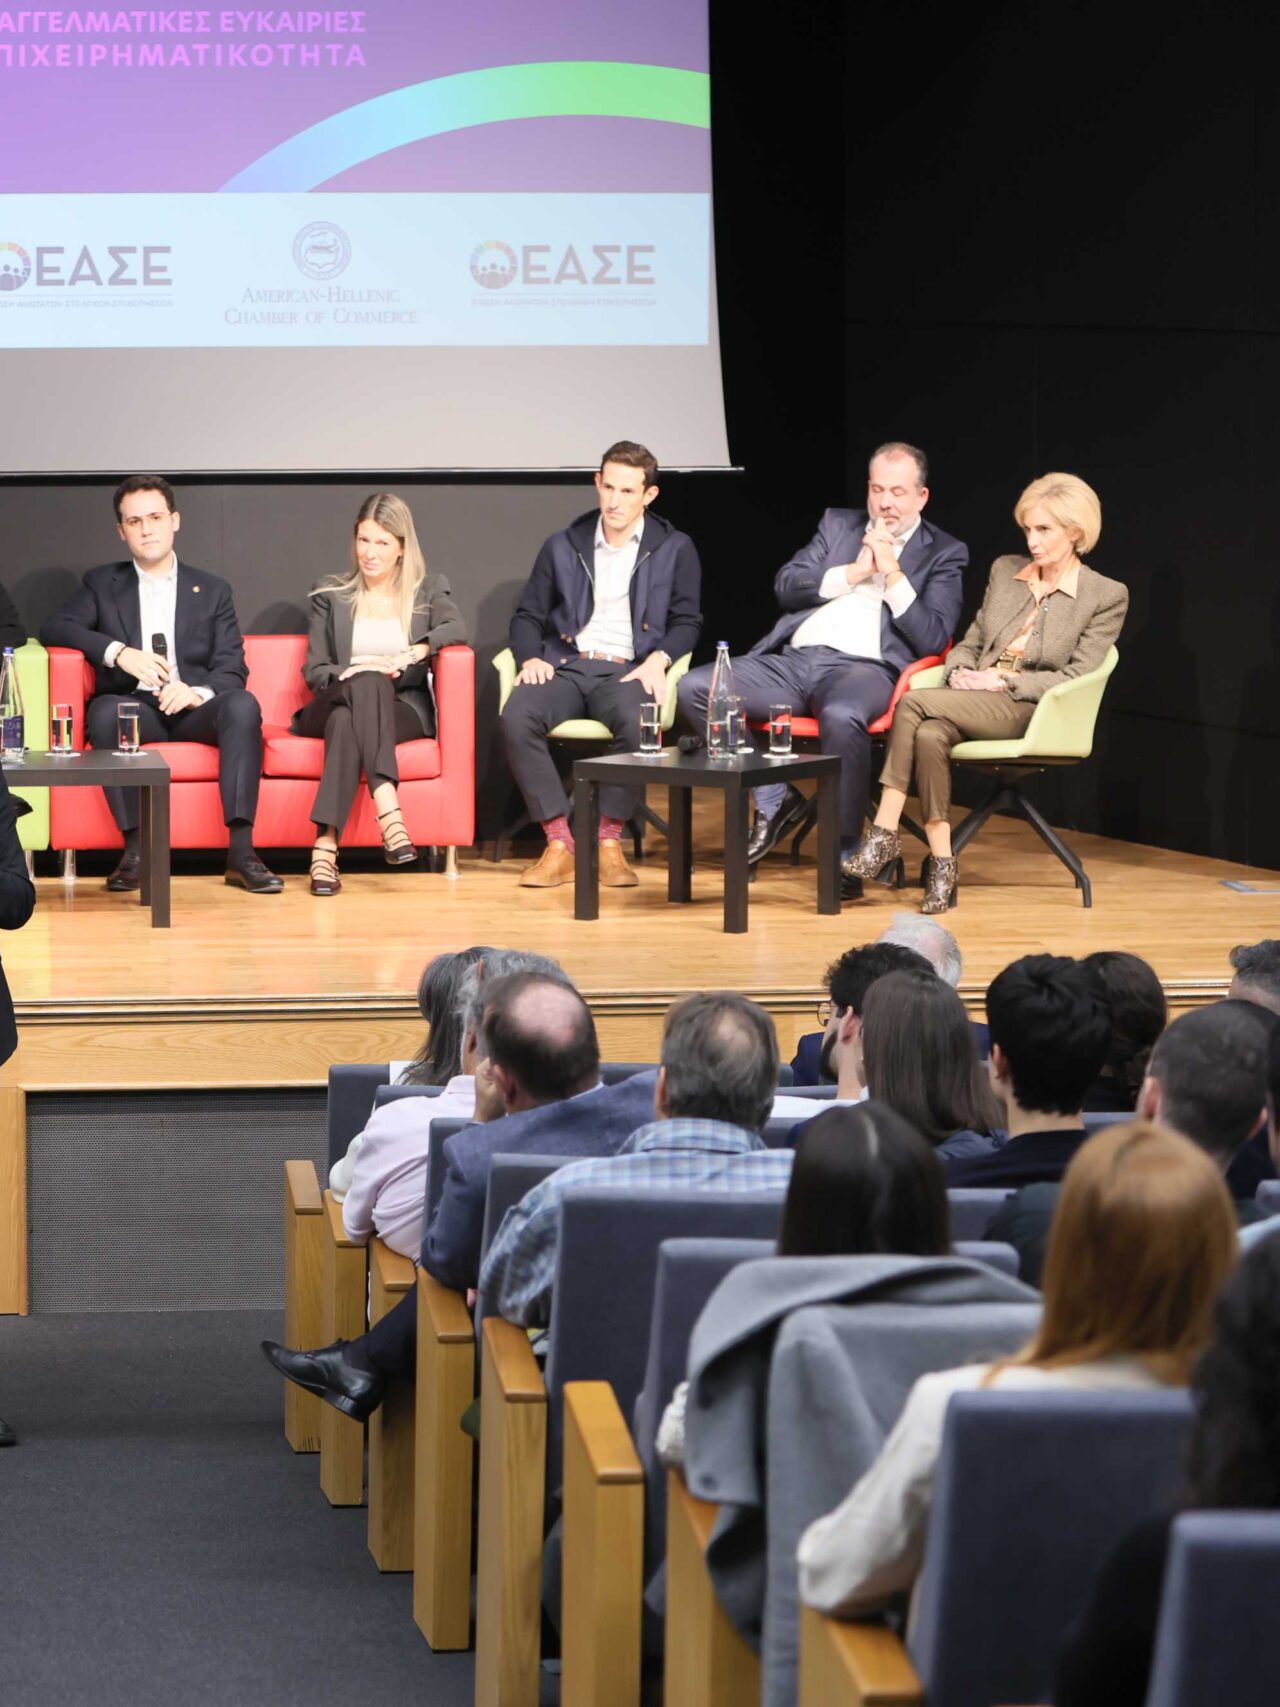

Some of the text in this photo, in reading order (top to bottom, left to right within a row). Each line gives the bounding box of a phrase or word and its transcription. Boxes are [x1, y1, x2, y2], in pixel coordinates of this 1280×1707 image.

[220, 11, 366, 33] ΕΥΚΑΙΡΙΕΣ
[36, 244, 173, 286] ΕΑΣΕ
[522, 243, 656, 285] ΕΑΣΕ
[224, 307, 419, 325] CHAMBER OF COMMERCE
